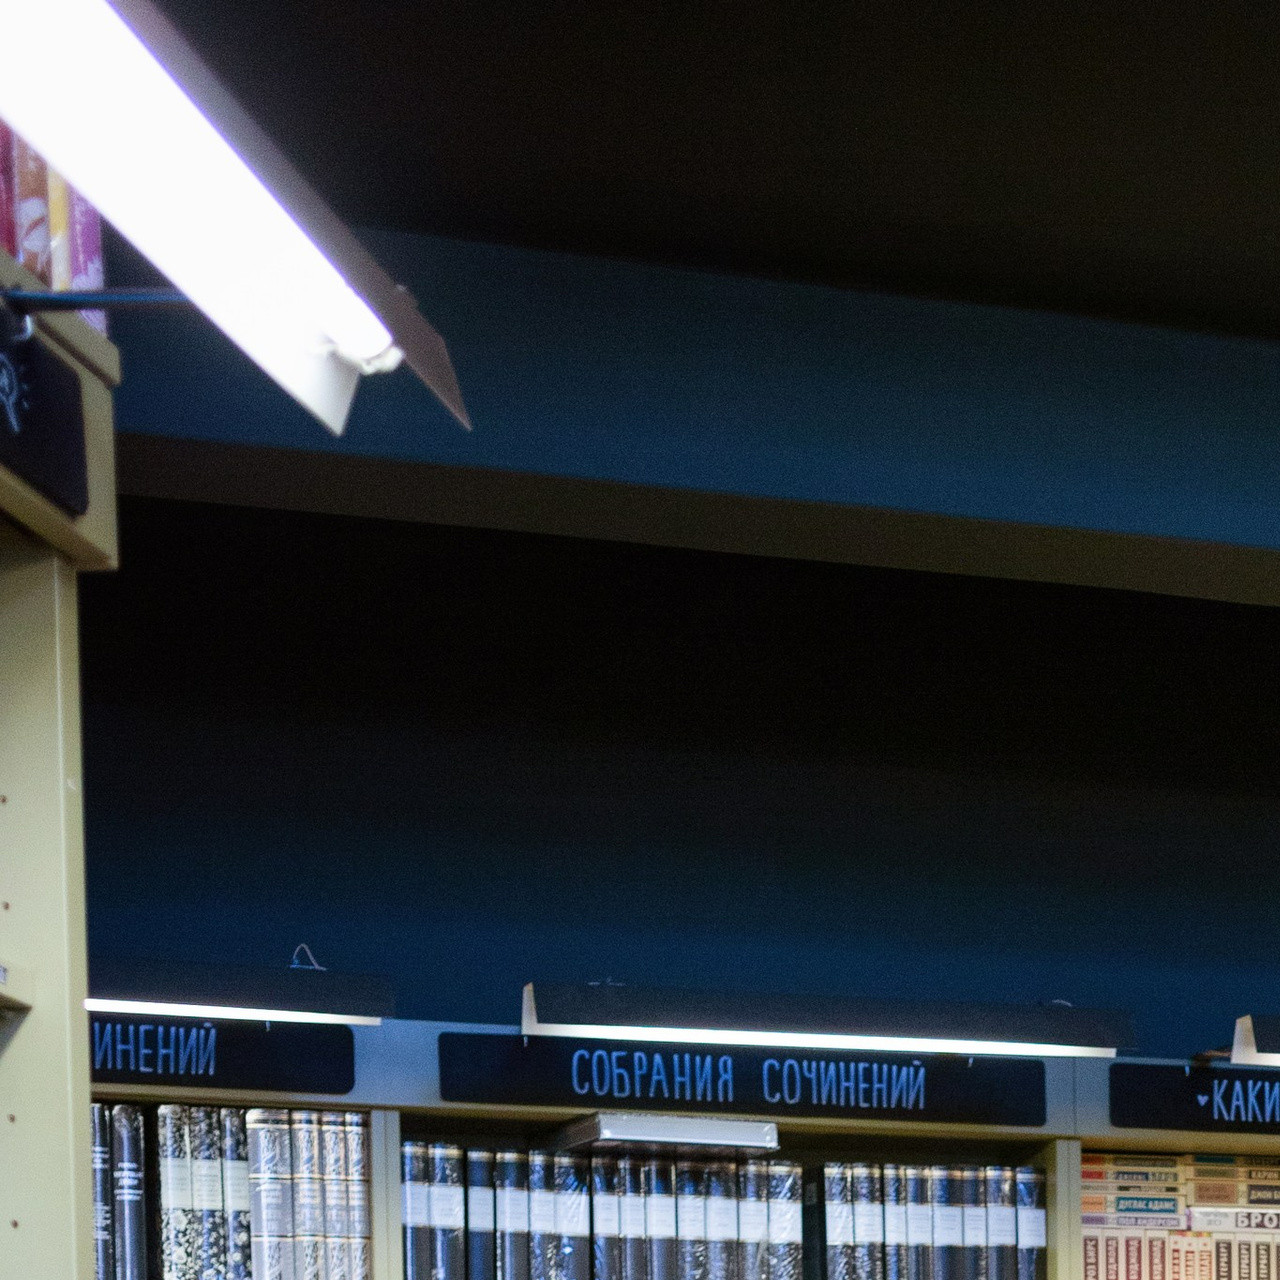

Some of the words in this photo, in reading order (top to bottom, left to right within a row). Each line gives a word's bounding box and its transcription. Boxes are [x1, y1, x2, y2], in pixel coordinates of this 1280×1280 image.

[92, 1021, 217, 1079] ИНЕНИЙ
[571, 1049, 735, 1104] СОБРАНИЯ
[762, 1058, 928, 1114] СОЧИНЕНИЙ
[1117, 1199, 1146, 1211] ДУГЛАС
[1147, 1200, 1176, 1212] АДАМС
[1086, 1239, 1097, 1262] БИРС
[1218, 1242, 1230, 1276] ГЕРБЕРТ
[1240, 1243, 1250, 1278] ГЕРБЕРТ
[1258, 1244, 1269, 1278] ГЕРБЕРТ
